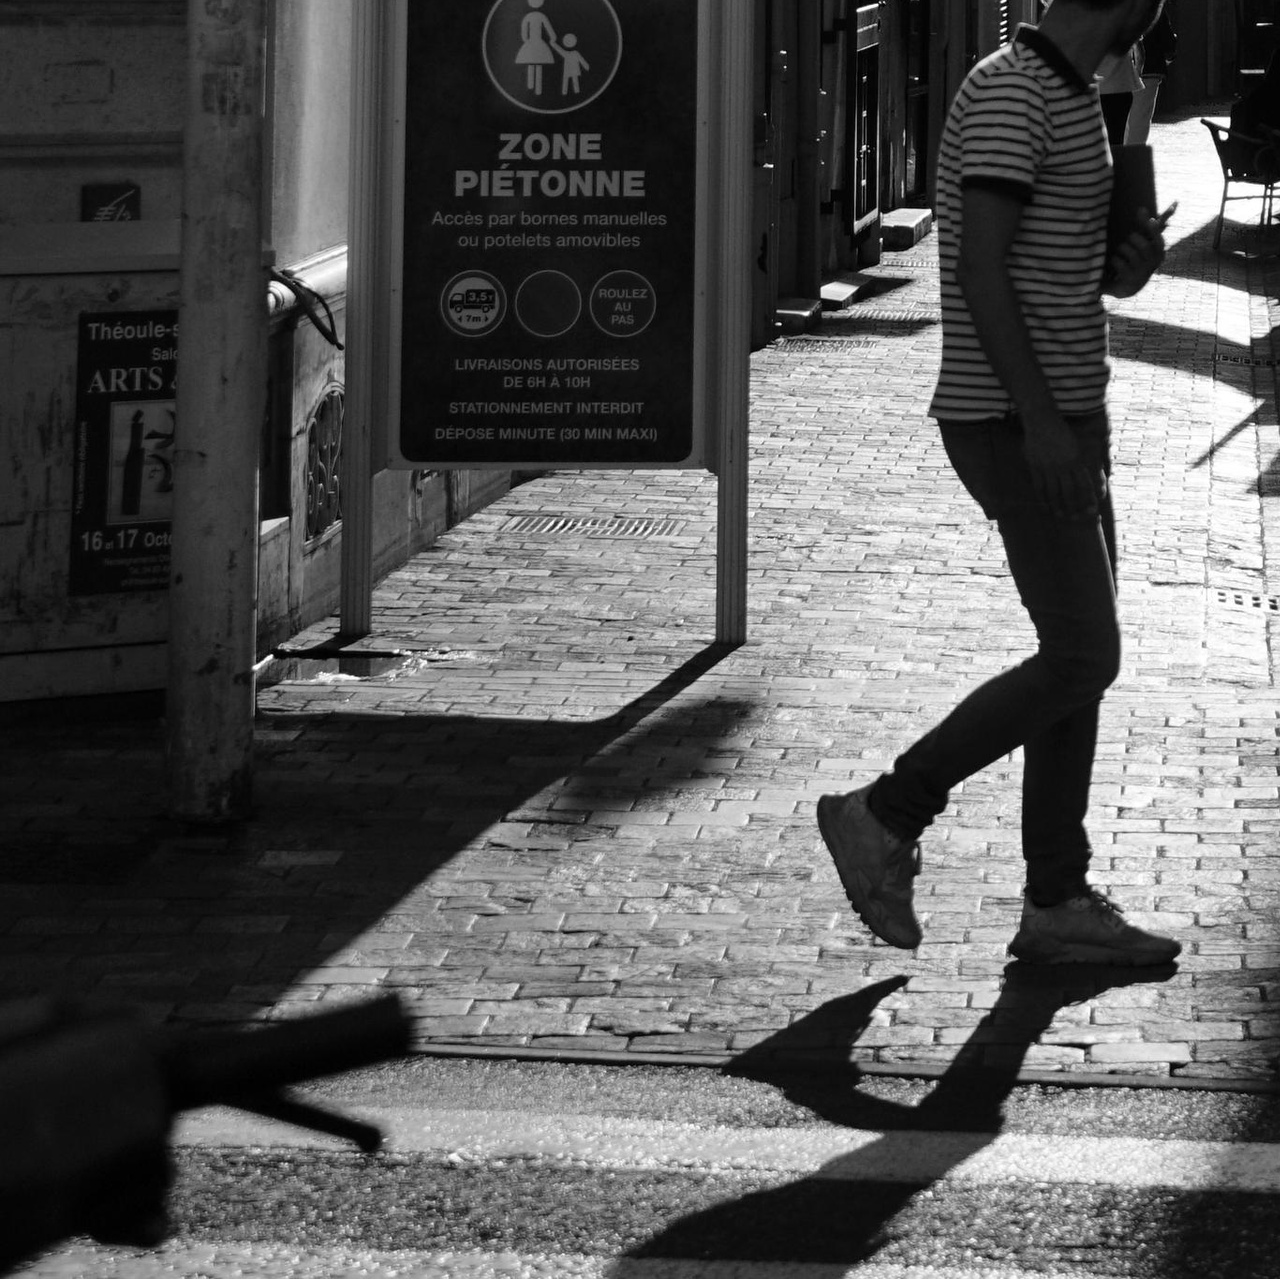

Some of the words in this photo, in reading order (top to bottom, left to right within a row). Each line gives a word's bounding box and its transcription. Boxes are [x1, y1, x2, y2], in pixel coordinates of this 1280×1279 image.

[498, 132, 603, 161] ZONE
[455, 163, 646, 198] PIÉTONNE
[432, 210, 484, 226] Accès
[488, 213, 517, 228] par
[520, 210, 579, 226] bornes
[583, 210, 668, 226] manuelles
[458, 236, 479, 248] ou
[484, 233, 552, 250] potelets
[556, 233, 641, 248] amovibles
[598, 288, 648, 299] ROULEZ
[614, 302, 632, 312] AU
[465, 315, 482, 323] 7m
[611, 314, 635, 325] PAS
[455, 359, 543, 371] LIVRAISONS
[546, 356, 640, 371] AUTORISÉES
[87, 366, 163, 393] ARTS
[503, 377, 524, 389] DE
[527, 377, 546, 389] 6H
[550, 373, 561, 389] À
[566, 377, 591, 389] 10H
[449, 402, 574, 414] STATIONNEMENT
[577, 402, 645, 414] INTERDIT
[435, 424, 495, 440] DÉPOSE
[499, 428, 556, 440] MINUTE
[560, 428, 581, 443] (30
[584, 428, 613, 440] MIN
[616, 428, 658, 443] MAXI)
[81, 530, 103, 552] 16
[117, 528, 139, 549] 17
